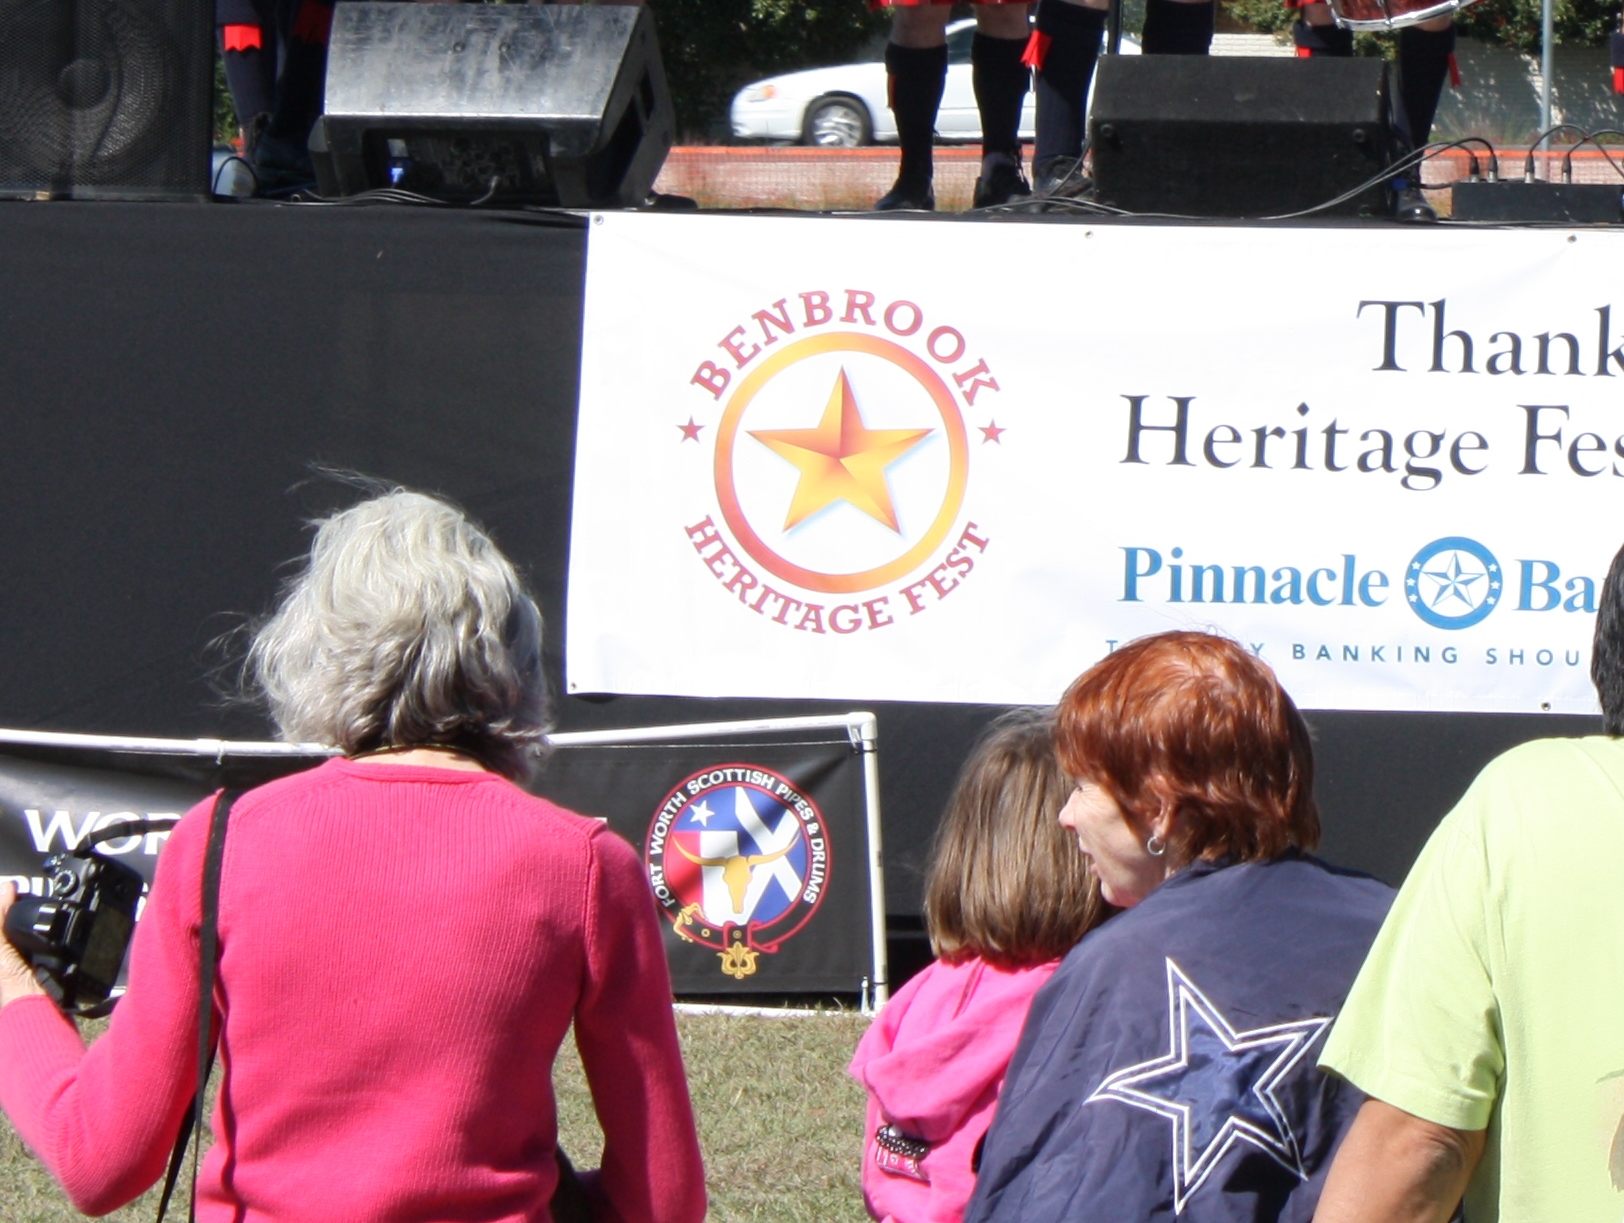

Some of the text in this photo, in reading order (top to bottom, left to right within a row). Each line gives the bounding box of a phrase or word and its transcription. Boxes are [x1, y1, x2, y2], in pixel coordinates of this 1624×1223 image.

[690, 289, 1001, 406] BENBROOK
[1119, 394, 1490, 492] Heritage
[683, 514, 991, 635] HERITAGE FEST
[1117, 546, 1603, 615] Pinnacle Ba
[1292, 643, 1459, 666] BANKING
[1485, 647, 1582, 668] SHOU
[649, 768, 826, 908] FORT WORTH SCOTTISH PIPES & DRUMS
